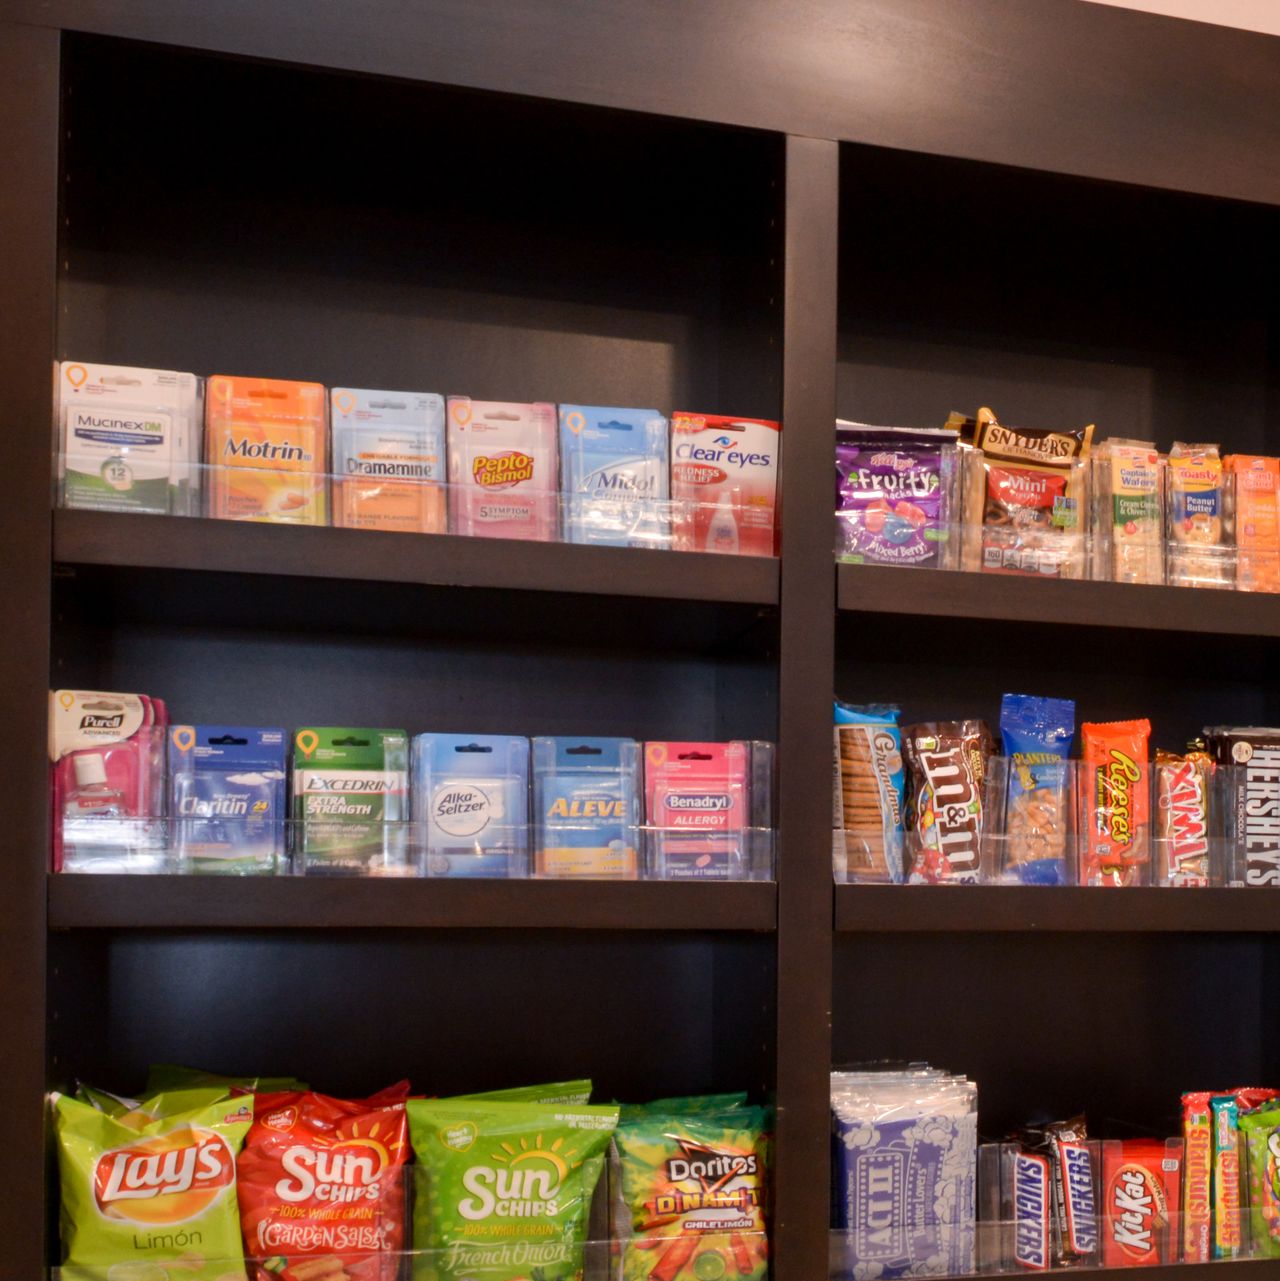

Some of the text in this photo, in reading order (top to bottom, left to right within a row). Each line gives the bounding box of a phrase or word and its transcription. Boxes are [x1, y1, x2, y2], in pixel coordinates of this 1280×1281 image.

[144, 420, 161, 432] DM
[224, 437, 303, 461] Motrin
[988, 428, 1070, 457] SNYDER'S
[473, 452, 533, 471] Pepto-
[675, 444, 770, 467] Clear eyes
[347, 458, 432, 477] Dramamine
[481, 466, 533, 485] Bismol
[1179, 469, 1217, 482] Toasty
[1007, 475, 1046, 493] Mini
[1121, 476, 1156, 487] Wafers
[1186, 496, 1215, 507] Peanut
[1187, 504, 1212, 513] Butter
[307, 777, 394, 792] EXCEDRIN
[179, 798, 268, 815] Claritin 24
[307, 796, 346, 805] EXTRA
[442, 793, 477, 805] Alka-
[547, 798, 627, 816] ALEVE
[670, 795, 726, 809] Benadryl
[1110, 749, 1142, 847] Reese's
[307, 804, 371, 815] STRENGTH
[436, 800, 485, 816] Seltzer
[674, 816, 726, 825] ALLERGY
[1167, 762, 1209, 873] TWIX
[102, 1140, 222, 1202] Lay's
[275, 1145, 377, 1202] Sun
[670, 1155, 756, 1182] Doritos
[315, 1183, 379, 1202] CHIPS
[458, 1165, 561, 1220] Sun
[1066, 1149, 1097, 1253] SNICKERS
[278, 1205, 373, 1220] 100% WHOLE GRAIN
[495, 1203, 558, 1218] CHIPS
[1016, 1157, 1043, 1265] SNICKERS
[682, 1220, 718, 1230] CHILE
[133, 1228, 202, 1250] Limón
[447, 1240, 567, 1274] French Onion
